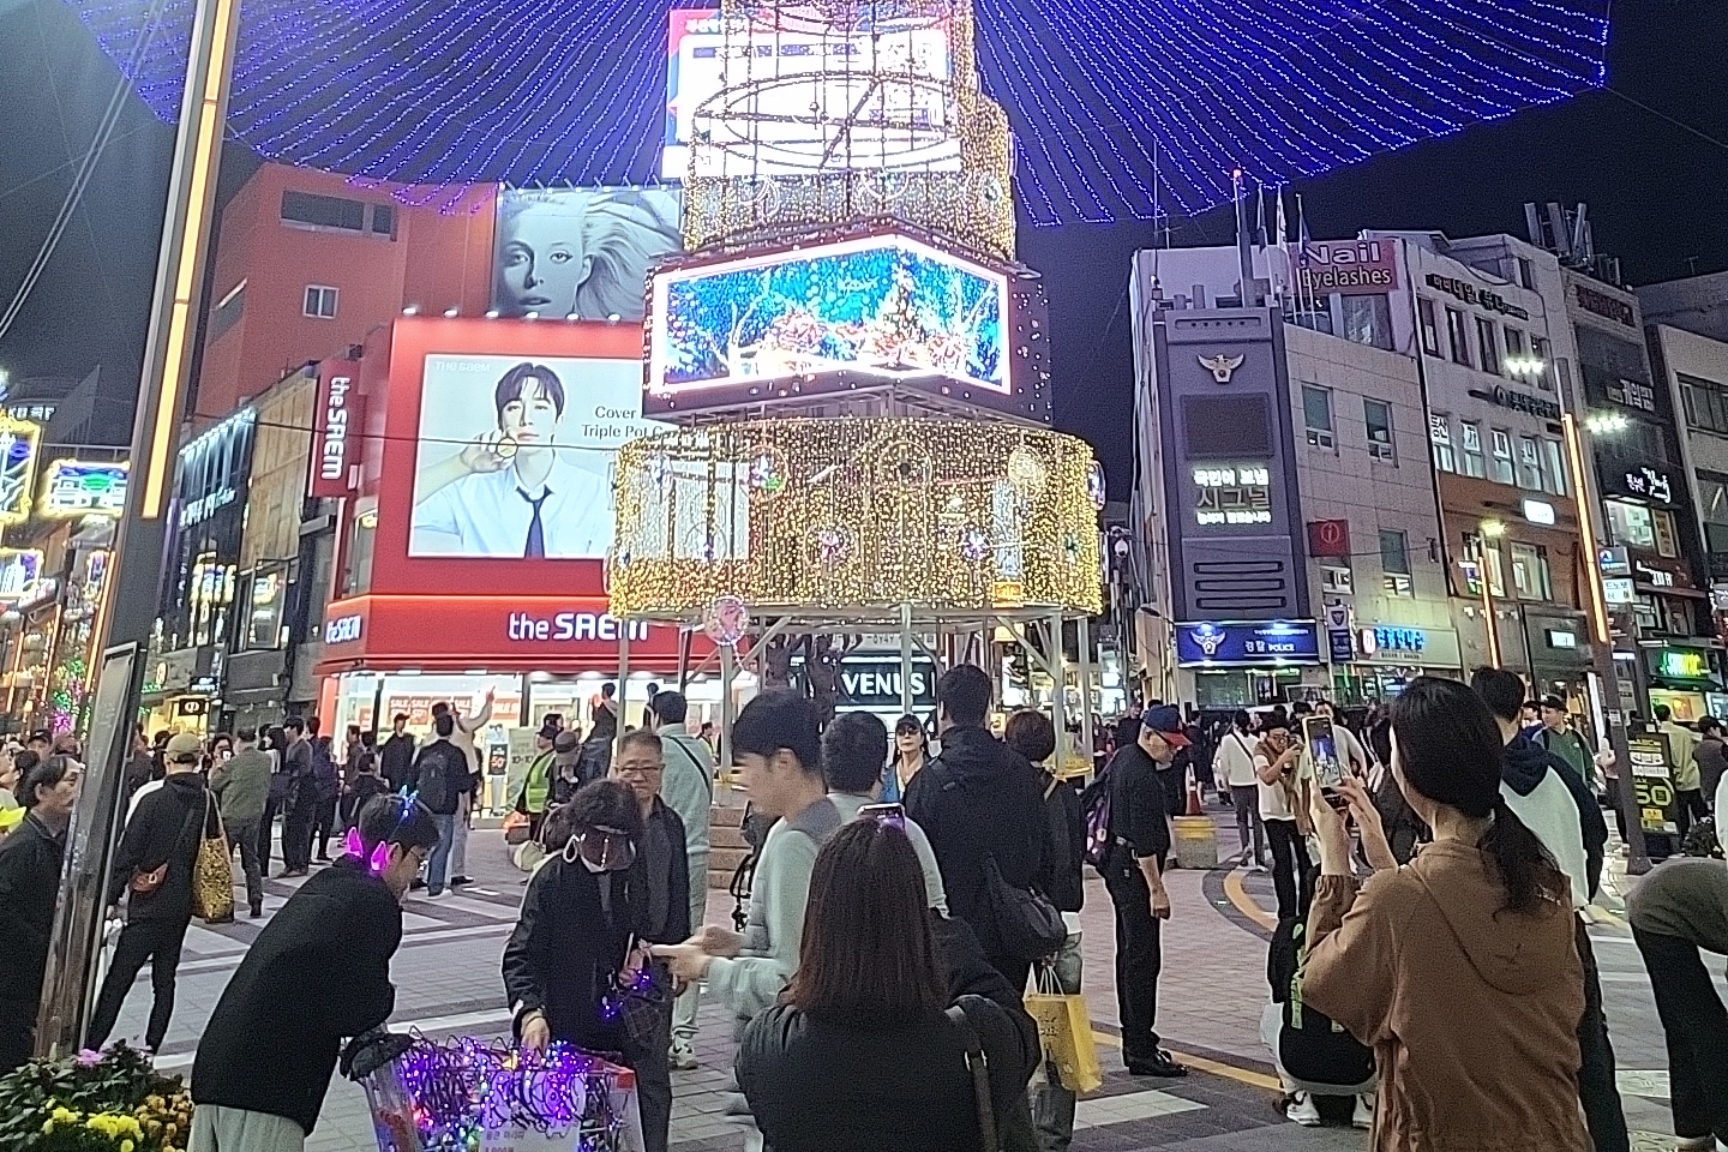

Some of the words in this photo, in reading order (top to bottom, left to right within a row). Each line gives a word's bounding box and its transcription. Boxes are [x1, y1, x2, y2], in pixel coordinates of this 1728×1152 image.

[1305, 242, 1380, 264] Nail
[1302, 266, 1392, 290] Eyelashes
[328, 376, 351, 408] the
[594, 405, 637, 419] Cover
[581, 424, 621, 440] Triple
[625, 425, 648, 438] Pot
[1196, 486, 1271, 511] 시그널
[508, 612, 550, 640] the
[1245, 640, 1266, 653] 경찰
[1267, 643, 1295, 652] POLICE
[841, 672, 926, 696] VENUS
